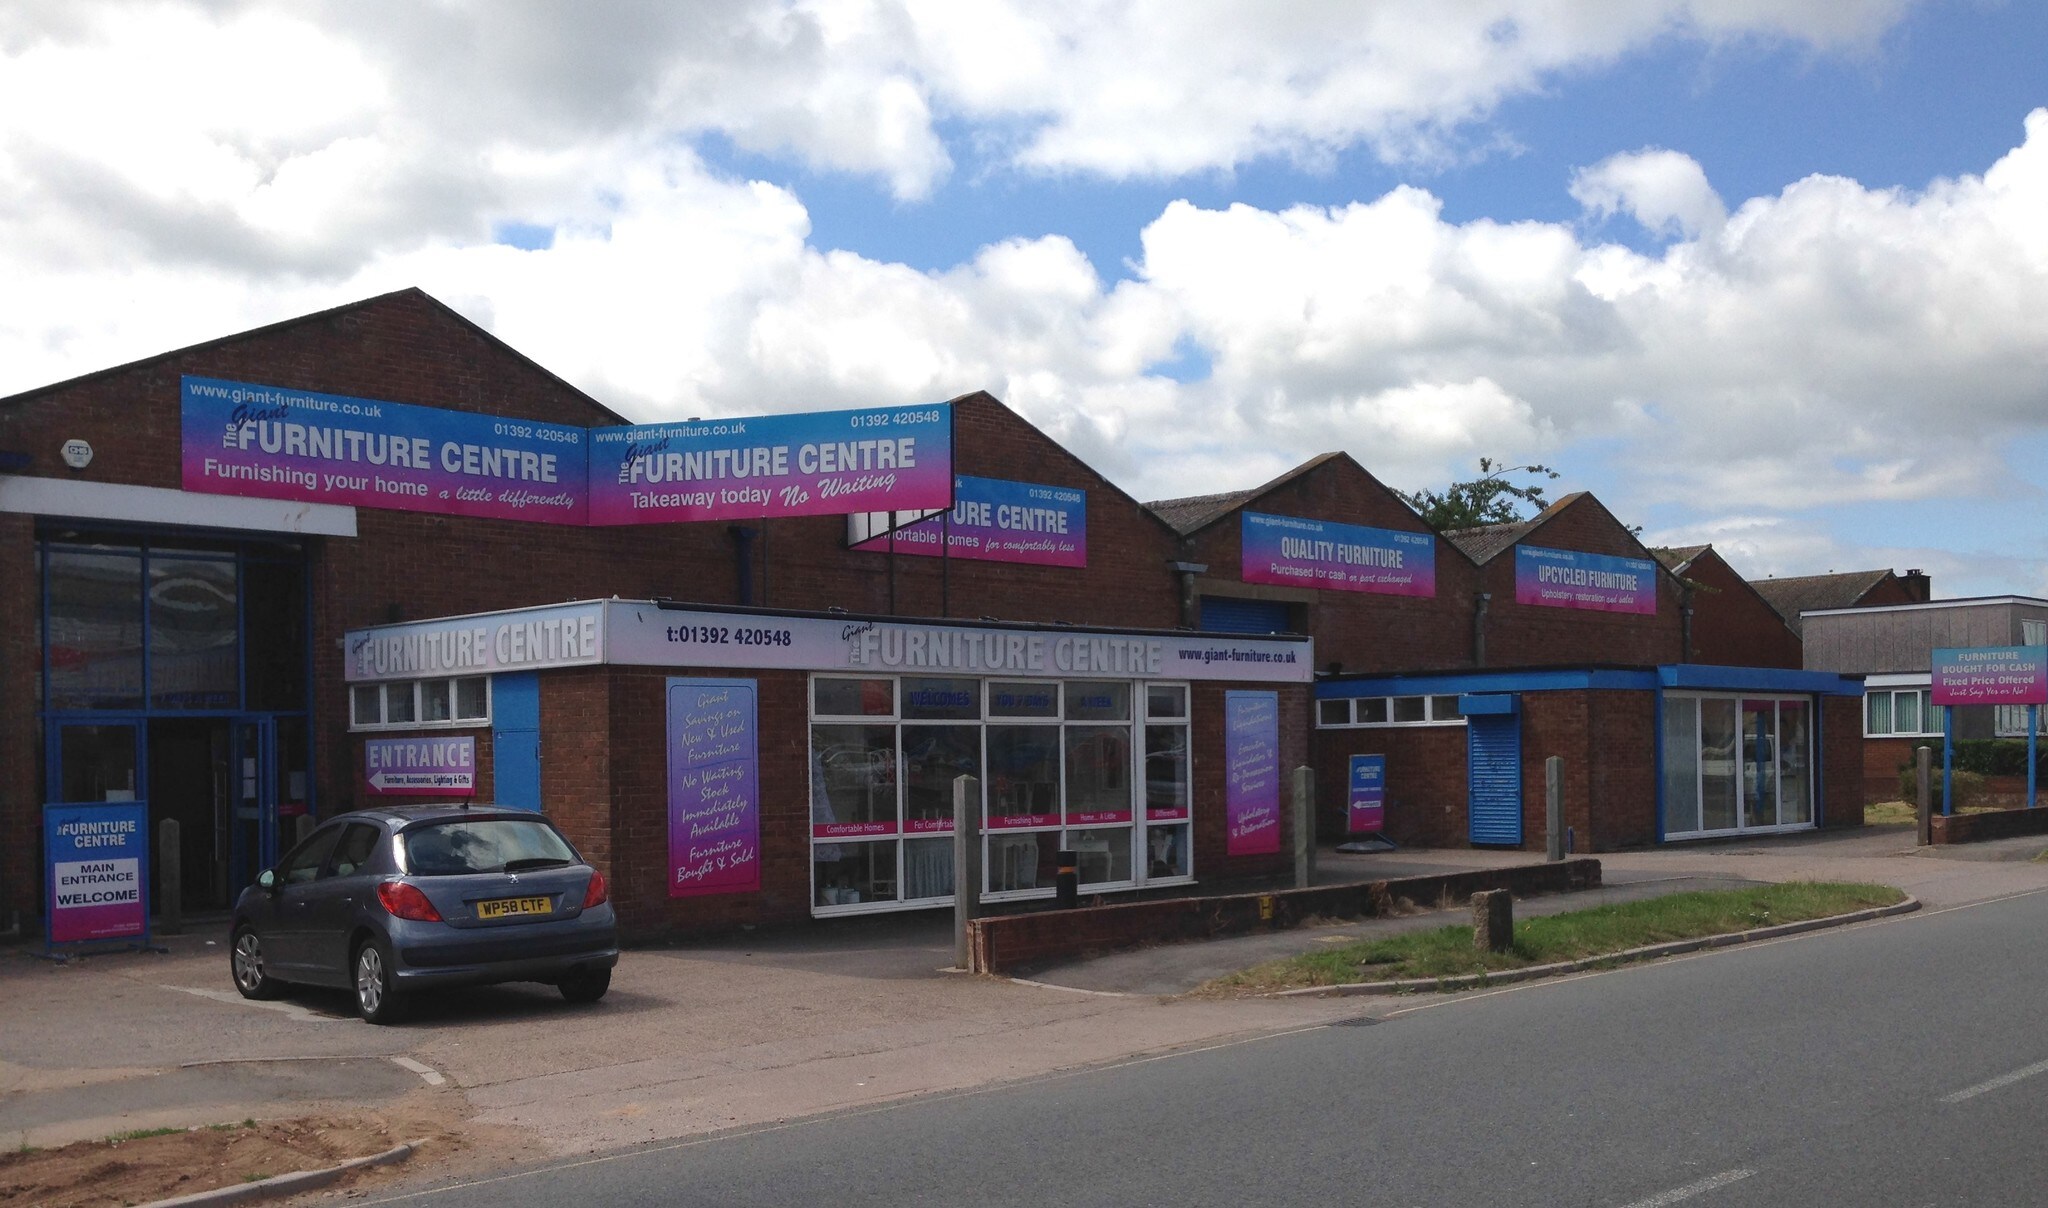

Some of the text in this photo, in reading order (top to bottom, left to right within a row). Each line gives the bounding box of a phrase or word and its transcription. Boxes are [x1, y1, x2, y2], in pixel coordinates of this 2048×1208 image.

[190, 384, 382, 418] www.giant-furniture.co.uk
[232, 403, 289, 430] Giant
[851, 410, 940, 429] 01392 420548
[223, 423, 237, 449] The
[494, 422, 578, 444] 01392 420548
[595, 422, 746, 443] www.giant-furniture.co.uk
[238, 420, 558, 483] FURNITURE CENTRE
[625, 437, 670, 464] Giant
[630, 437, 916, 485] FURNITURE CENTRE
[204, 458, 575, 510] Furnishing your home a little differently
[618, 462, 630, 485] The
[630, 472, 897, 510] Takeaway today No Waiting
[1029, 488, 1052, 501] 01392
[997, 505, 1068, 535] CENTRE
[985, 537, 1001, 552] for
[1003, 538, 1056, 553] comfortably
[1058, 541, 1076, 552] less
[1281, 536, 1403, 569] QUALITY FURNITURE
[1271, 563, 1313, 578] Purchased
[1315, 567, 1327, 578] for
[1328, 569, 1346, 581] cash
[1538, 565, 1637, 591] UPCYCLED FURNITURE
[1576, 592, 1606, 604] restoration
[666, 625, 792, 647] t:01392 420548
[842, 620, 874, 641] Giant
[363, 615, 597, 676] FURNITURE CENTRE
[849, 639, 861, 663] The
[861, 628, 1162, 675] FURNITURE CENTRE
[1178, 647, 1297, 665] www.giant-furniture.co.uk
[1958, 651, 2019, 662] FURNITURE
[1942, 663, 2036, 674] BOUGHT FOR CASH
[1943, 675, 2035, 686] Fixed Price Offered
[697, 690, 729, 708] Giant
[1949, 688, 1968, 697] Just
[1969, 687, 1984, 698] Say
[1986, 687, 1998, 696] Yes
[2012, 686, 2028, 695] No!
[685, 708, 741, 729] Savings on
[681, 720, 745, 748] New & Used
[369, 743, 470, 768] ENTRANCE
[687, 743, 740, 765] Furniture
[434, 774, 453, 786] Lighting
[458, 775, 470, 784] Gifts
[681, 774, 697, 790] No
[700, 783, 729, 802] Stock
[682, 799, 748, 823] Immediately
[1004, 816, 1032, 826] Furnishing
[62, 820, 136, 836] FURNITURE
[690, 817, 740, 839] Available
[826, 822, 885, 835] Comfortable Homes
[914, 820, 924, 830] For
[75, 834, 126, 848] CENTRE
[689, 837, 743, 863] Furniture
[80, 863, 115, 874] MAIN
[677, 847, 755, 883] Bought & Sold
[61, 872, 134, 886] ENTRANCE
[57, 889, 138, 906] WELCOME
[483, 899, 544, 915] WP58 CTF
